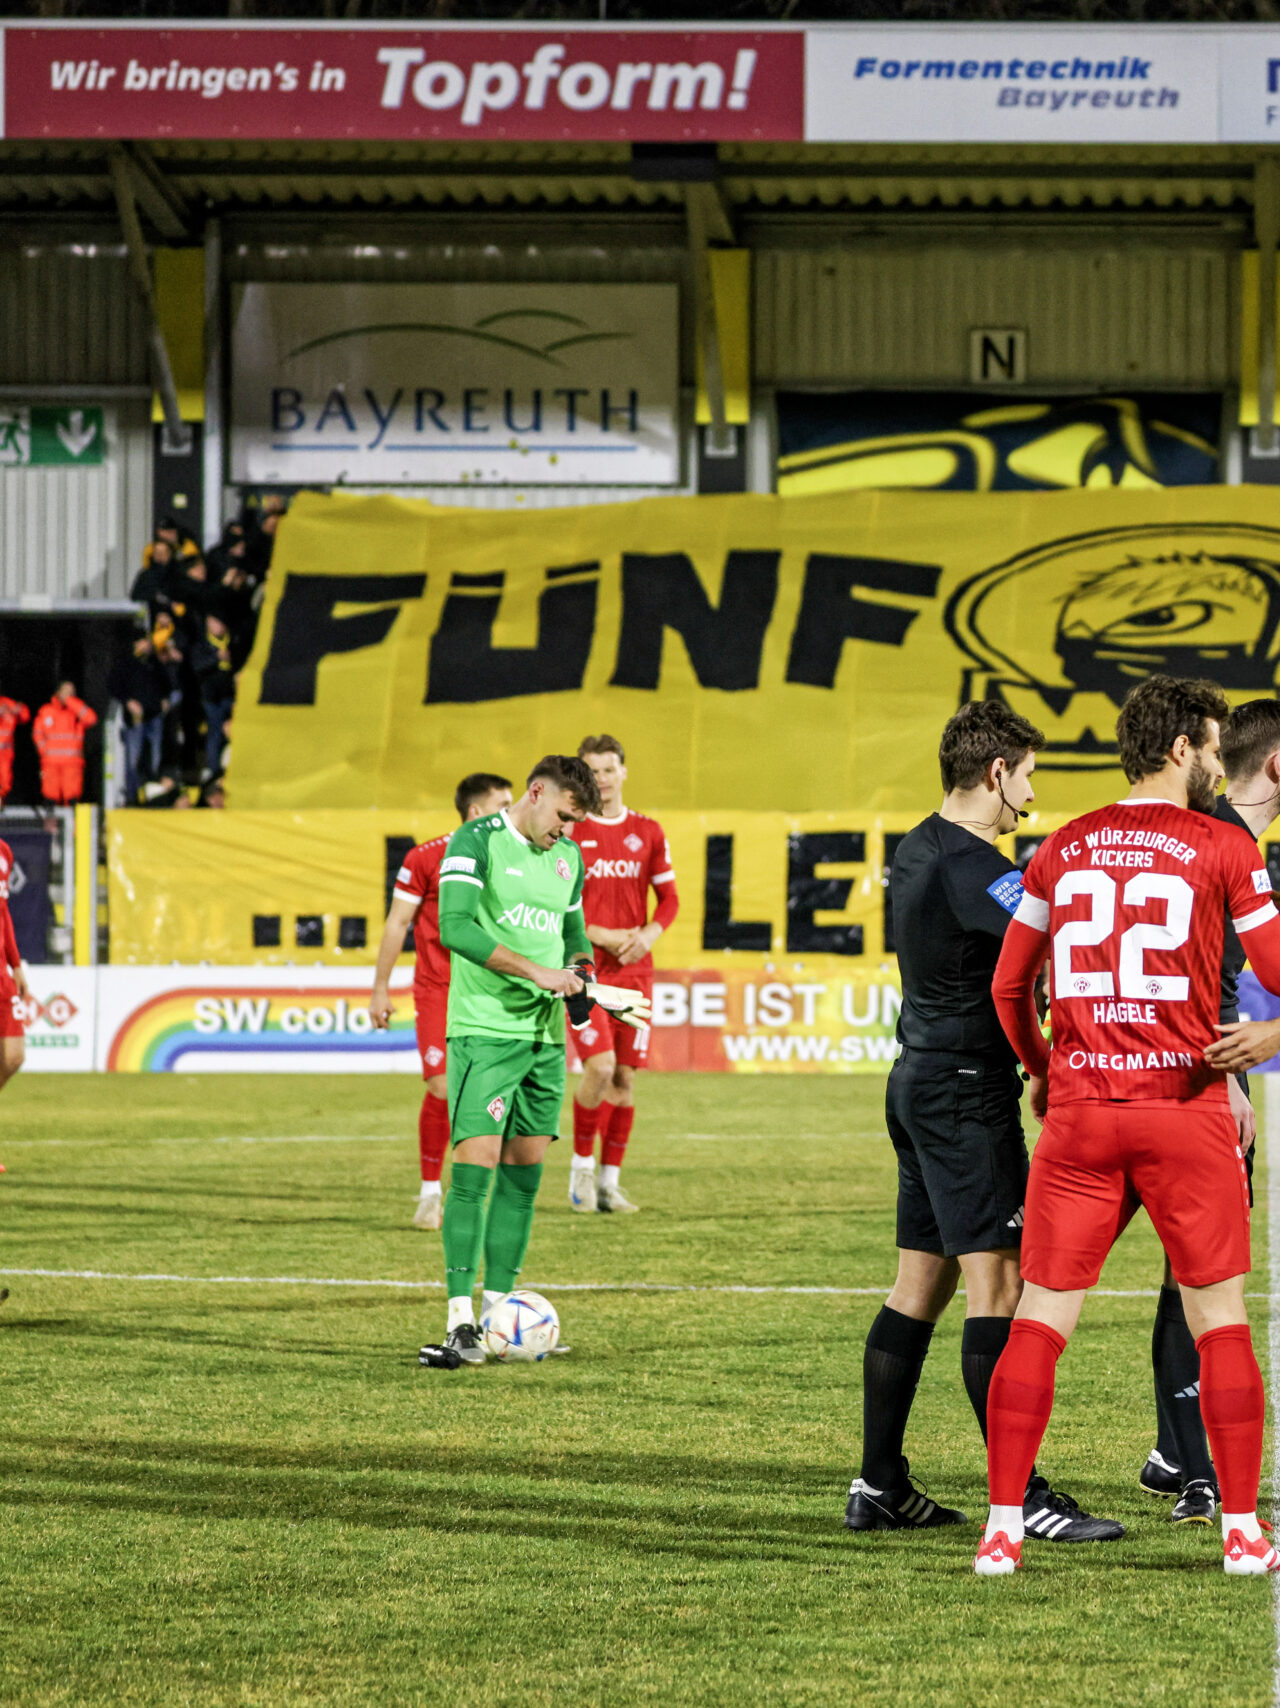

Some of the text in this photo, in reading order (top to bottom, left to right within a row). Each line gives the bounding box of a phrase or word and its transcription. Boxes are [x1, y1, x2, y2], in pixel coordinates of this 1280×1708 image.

[51, 59, 346, 98] Wir bringen's in
[377, 43, 758, 126] Topform!
[853, 56, 1152, 80] Formentechnik
[997, 86, 1180, 111] Bayreuth
[981, 335, 1014, 378] N
[270, 388, 639, 449] BAYREUTH
[258, 548, 943, 706] FÜNF
[1060, 826, 1197, 865] FC WÜRZBURGER
[1090, 849, 1154, 868] KICKERS
[993, 881, 1011, 896] WIR
[496, 902, 561, 935] AKON
[1053, 869, 1195, 1001] 22
[193, 997, 388, 1035] SW colo
[744, 983, 826, 1027] IST
[1093, 997, 1157, 1025] HÄGELE
